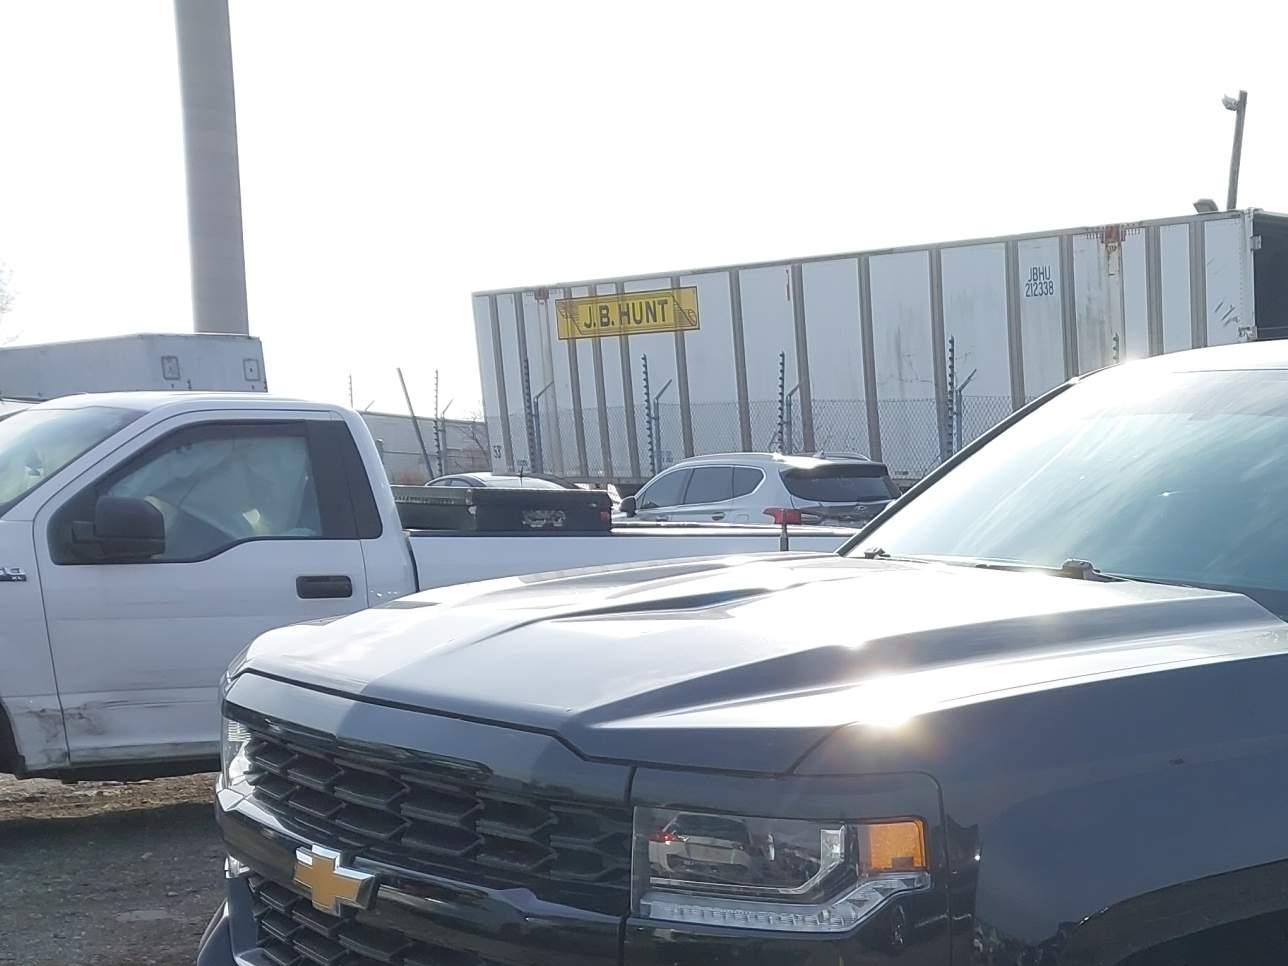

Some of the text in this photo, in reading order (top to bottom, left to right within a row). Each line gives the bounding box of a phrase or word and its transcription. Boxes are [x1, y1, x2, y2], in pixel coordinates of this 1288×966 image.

[1027, 265, 1050, 282] JBHU
[1025, 280, 1054, 297] 212338
[583, 299, 668, 328] J.B. HUNT
